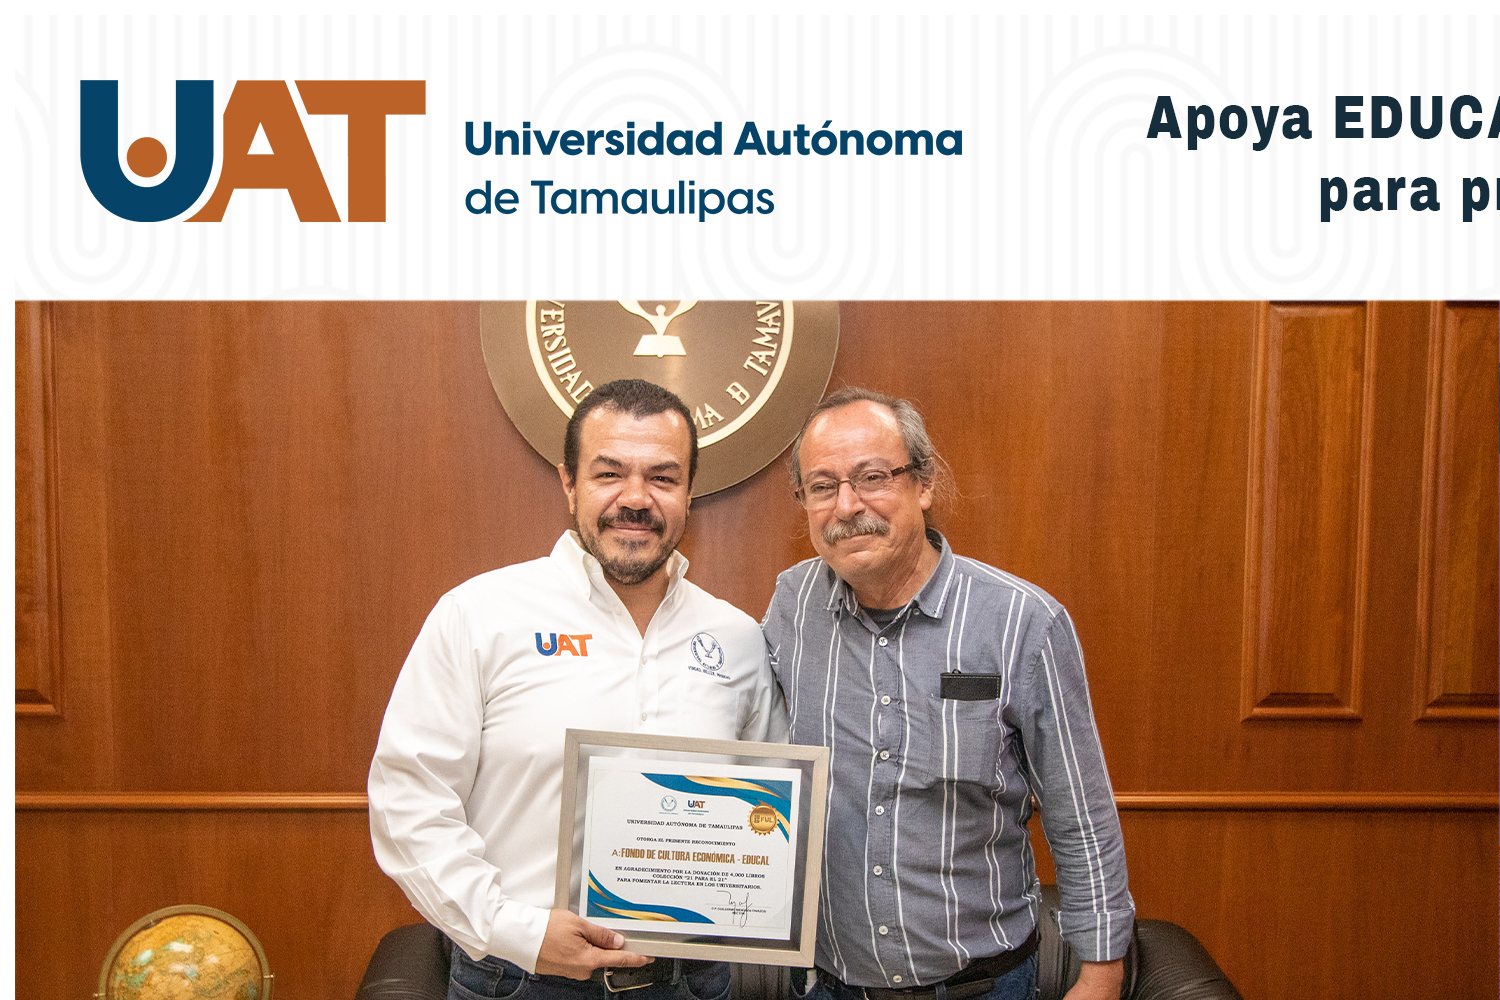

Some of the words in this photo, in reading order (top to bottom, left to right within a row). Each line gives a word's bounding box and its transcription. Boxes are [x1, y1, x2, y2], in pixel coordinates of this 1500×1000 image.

[535, 632, 592, 656] UAT
[688, 800, 705, 808] UAT
[621, 848, 645, 858] FONDO
[647, 849, 655, 859] DE
[658, 850, 690, 861] CULTURA
[693, 851, 735, 864] ECONÓMICA
[742, 855, 769, 866] EDUCAL
